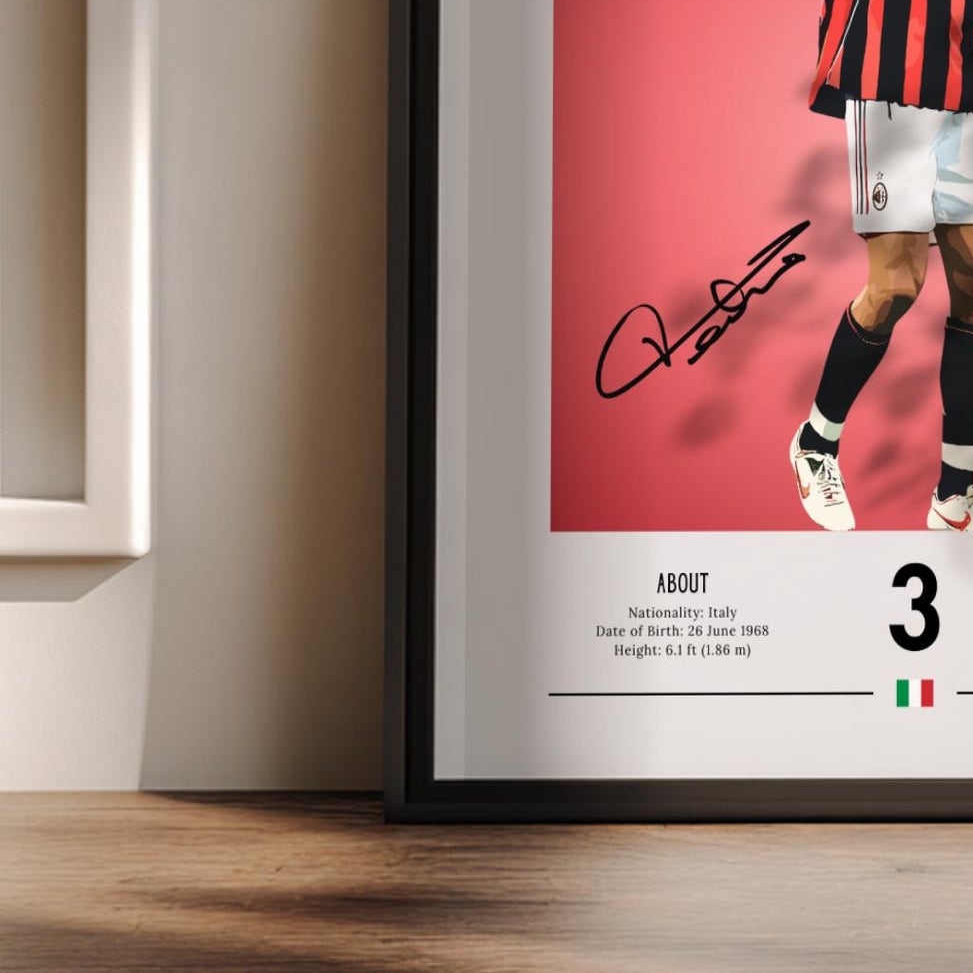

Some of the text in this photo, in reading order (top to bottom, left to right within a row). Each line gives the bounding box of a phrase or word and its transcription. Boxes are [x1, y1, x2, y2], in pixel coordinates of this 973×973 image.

[656, 572, 709, 594] ABOUT
[628, 606, 737, 622] Nationality: Italy
[888, 562, 940, 652] 3
[595, 624, 770, 638] Date of Birth: 26 June 1968
[614, 643, 752, 660] Height: 6.1 ft (1.86 m)
